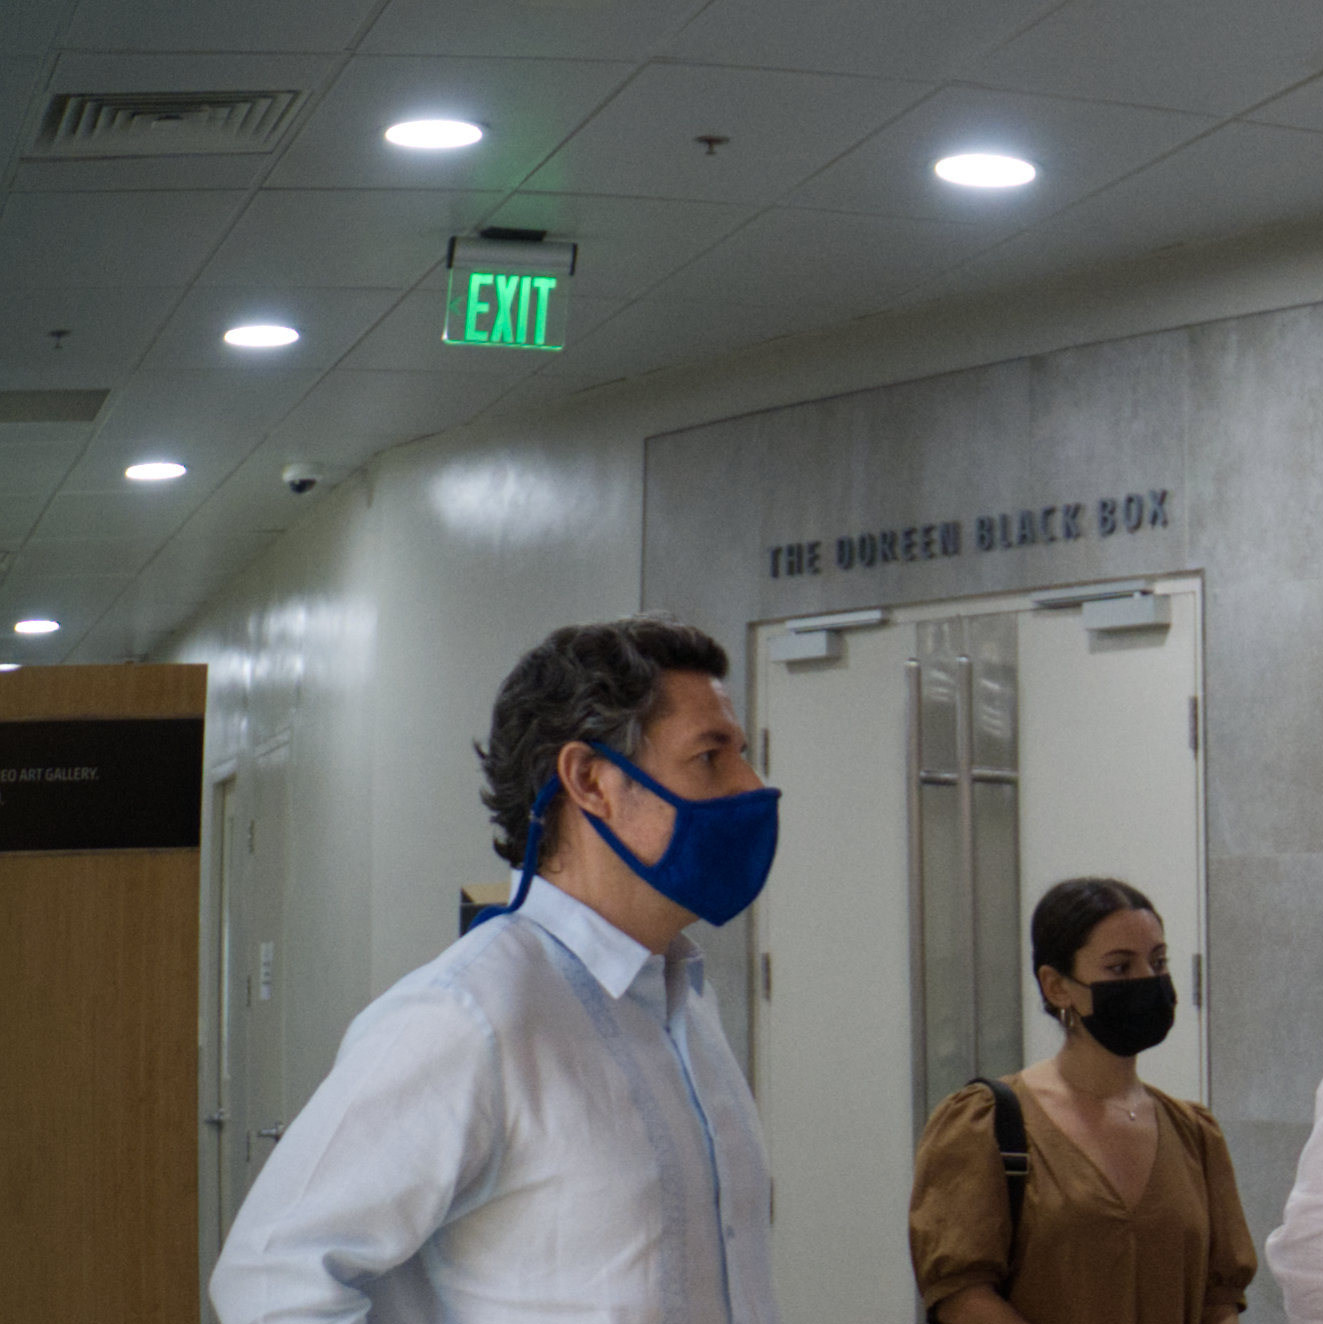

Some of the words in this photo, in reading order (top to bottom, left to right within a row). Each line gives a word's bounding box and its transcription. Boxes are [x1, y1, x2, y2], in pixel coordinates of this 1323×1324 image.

[464, 272, 557, 345] EXIT
[769, 540, 821, 578] THE
[835, 521, 960, 571] DOREEN
[975, 502, 1083, 552] BLACK
[1098, 489, 1169, 536] BOX
[20, 768, 42, 781] ART
